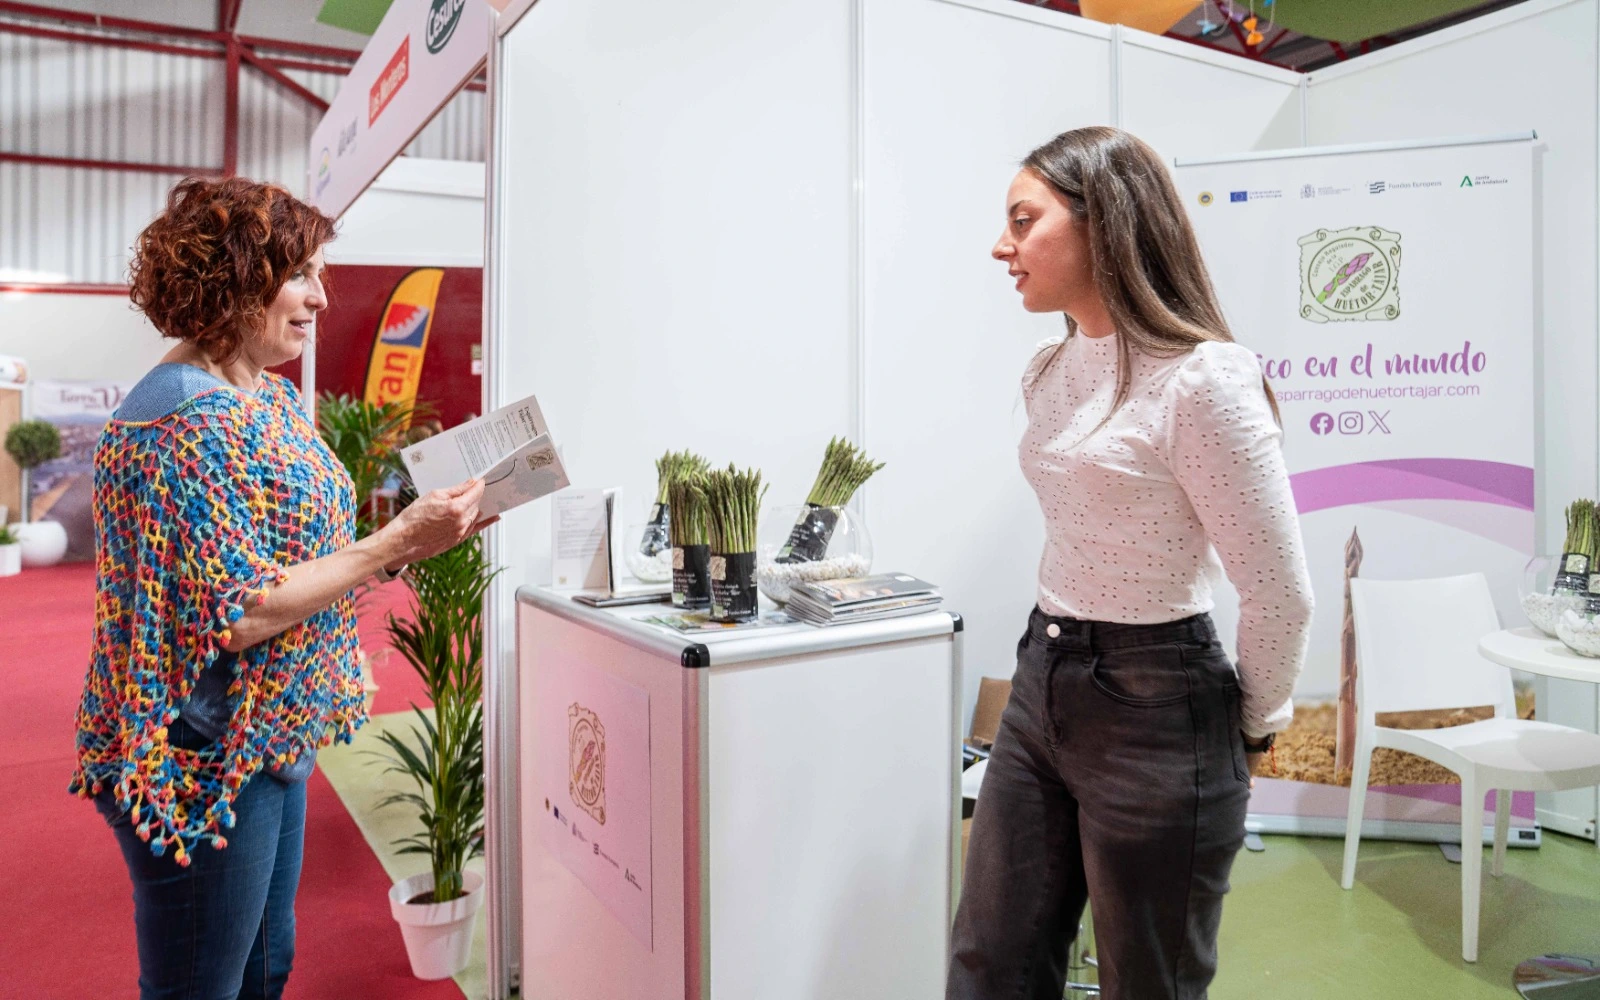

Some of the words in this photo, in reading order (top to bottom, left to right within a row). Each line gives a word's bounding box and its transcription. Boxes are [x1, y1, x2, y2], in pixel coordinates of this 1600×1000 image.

[1412, 180, 1442, 190] Europeos
[1360, 283, 1369, 293] de
[1304, 354, 1338, 378] en
[1350, 343, 1373, 379] el
[1385, 340, 1486, 377] mundo
[1274, 384, 1480, 404] sparragodehuetortajar.com
